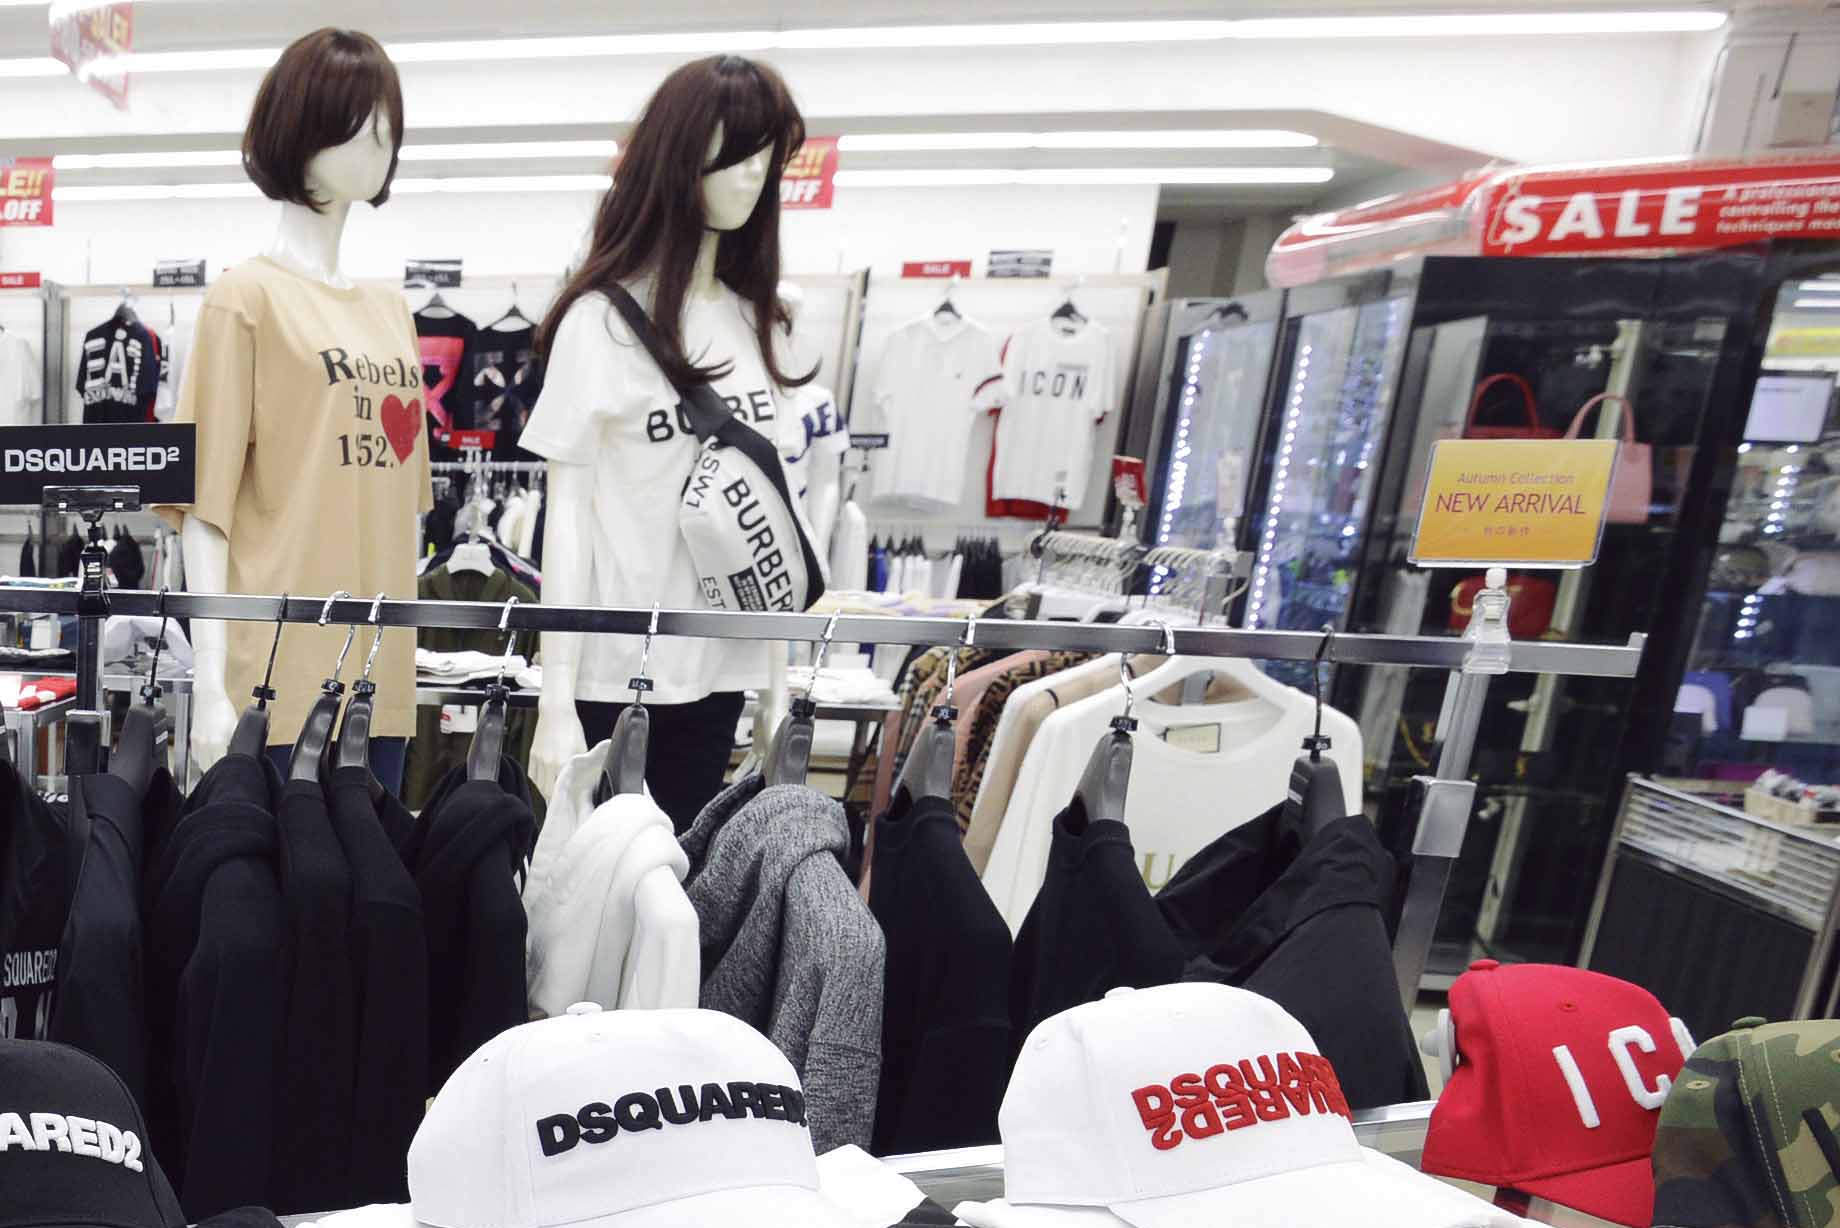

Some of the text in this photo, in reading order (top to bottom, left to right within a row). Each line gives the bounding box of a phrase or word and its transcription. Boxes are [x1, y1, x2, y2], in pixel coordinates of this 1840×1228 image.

[1503, 186, 1704, 246] SALE
[318, 346, 420, 389] Rebels
[1018, 369, 1088, 400] ICON
[353, 384, 373, 420] in
[1435, 492, 1587, 515] NEW ARRIVAL
